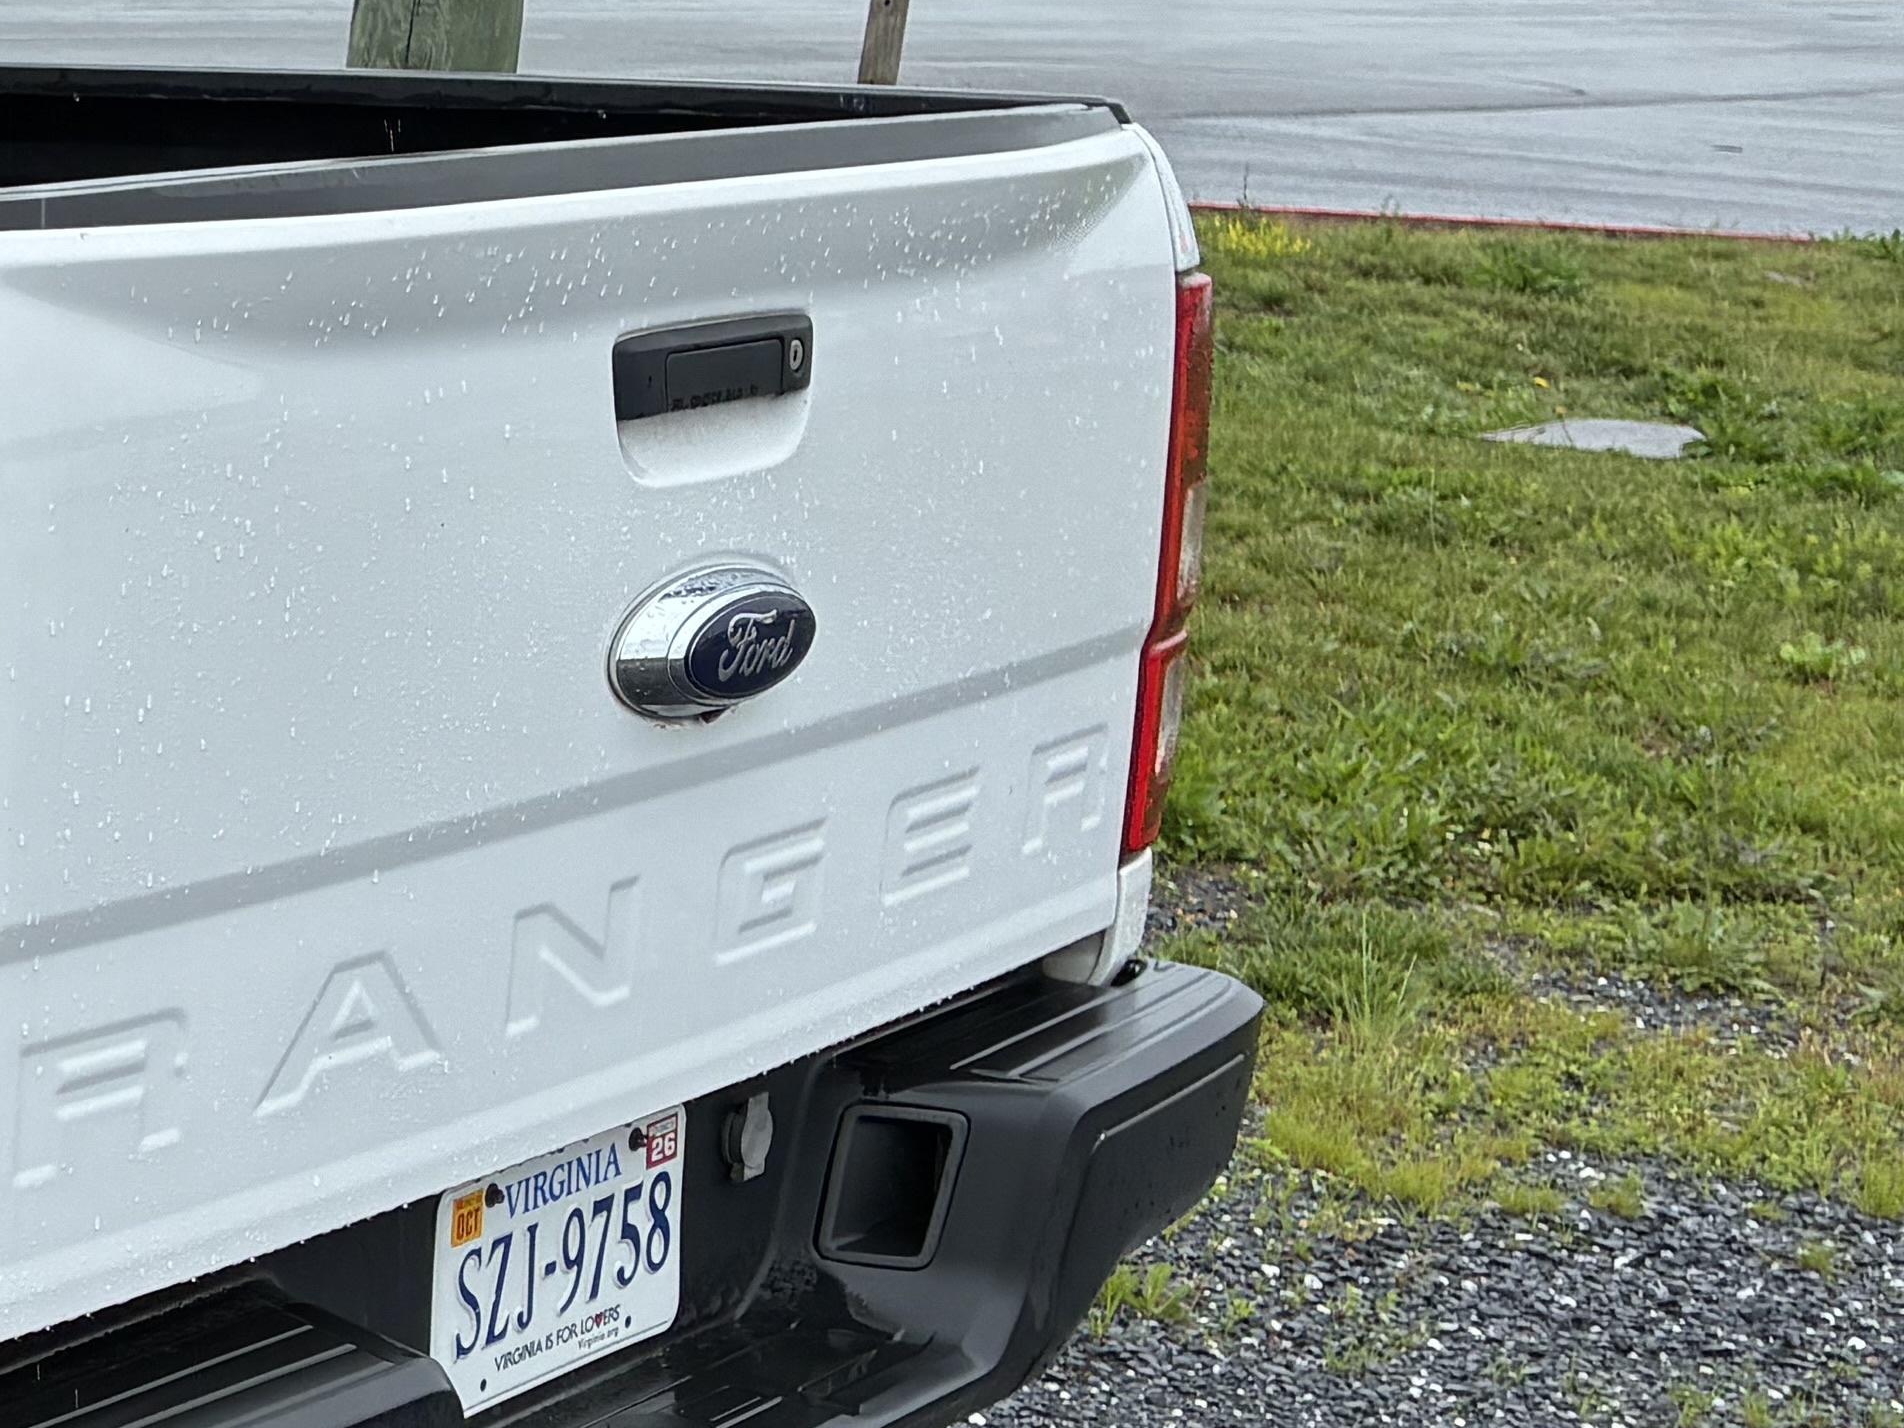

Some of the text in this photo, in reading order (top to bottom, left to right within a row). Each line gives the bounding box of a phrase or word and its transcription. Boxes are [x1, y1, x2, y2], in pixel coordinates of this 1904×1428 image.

[717, 608, 796, 682] Ford
[14, 723, 1110, 1190] RANGER
[504, 1142, 623, 1220] VIRGINIA
[651, 1132, 675, 1162] 26
[456, 1206, 481, 1240] OCT
[454, 1170, 673, 1357] SZJ-9758
[494, 1338, 543, 1372] VIRGINIA
[545, 1332, 554, 1351] IS
[556, 1322, 578, 1346] FOR
